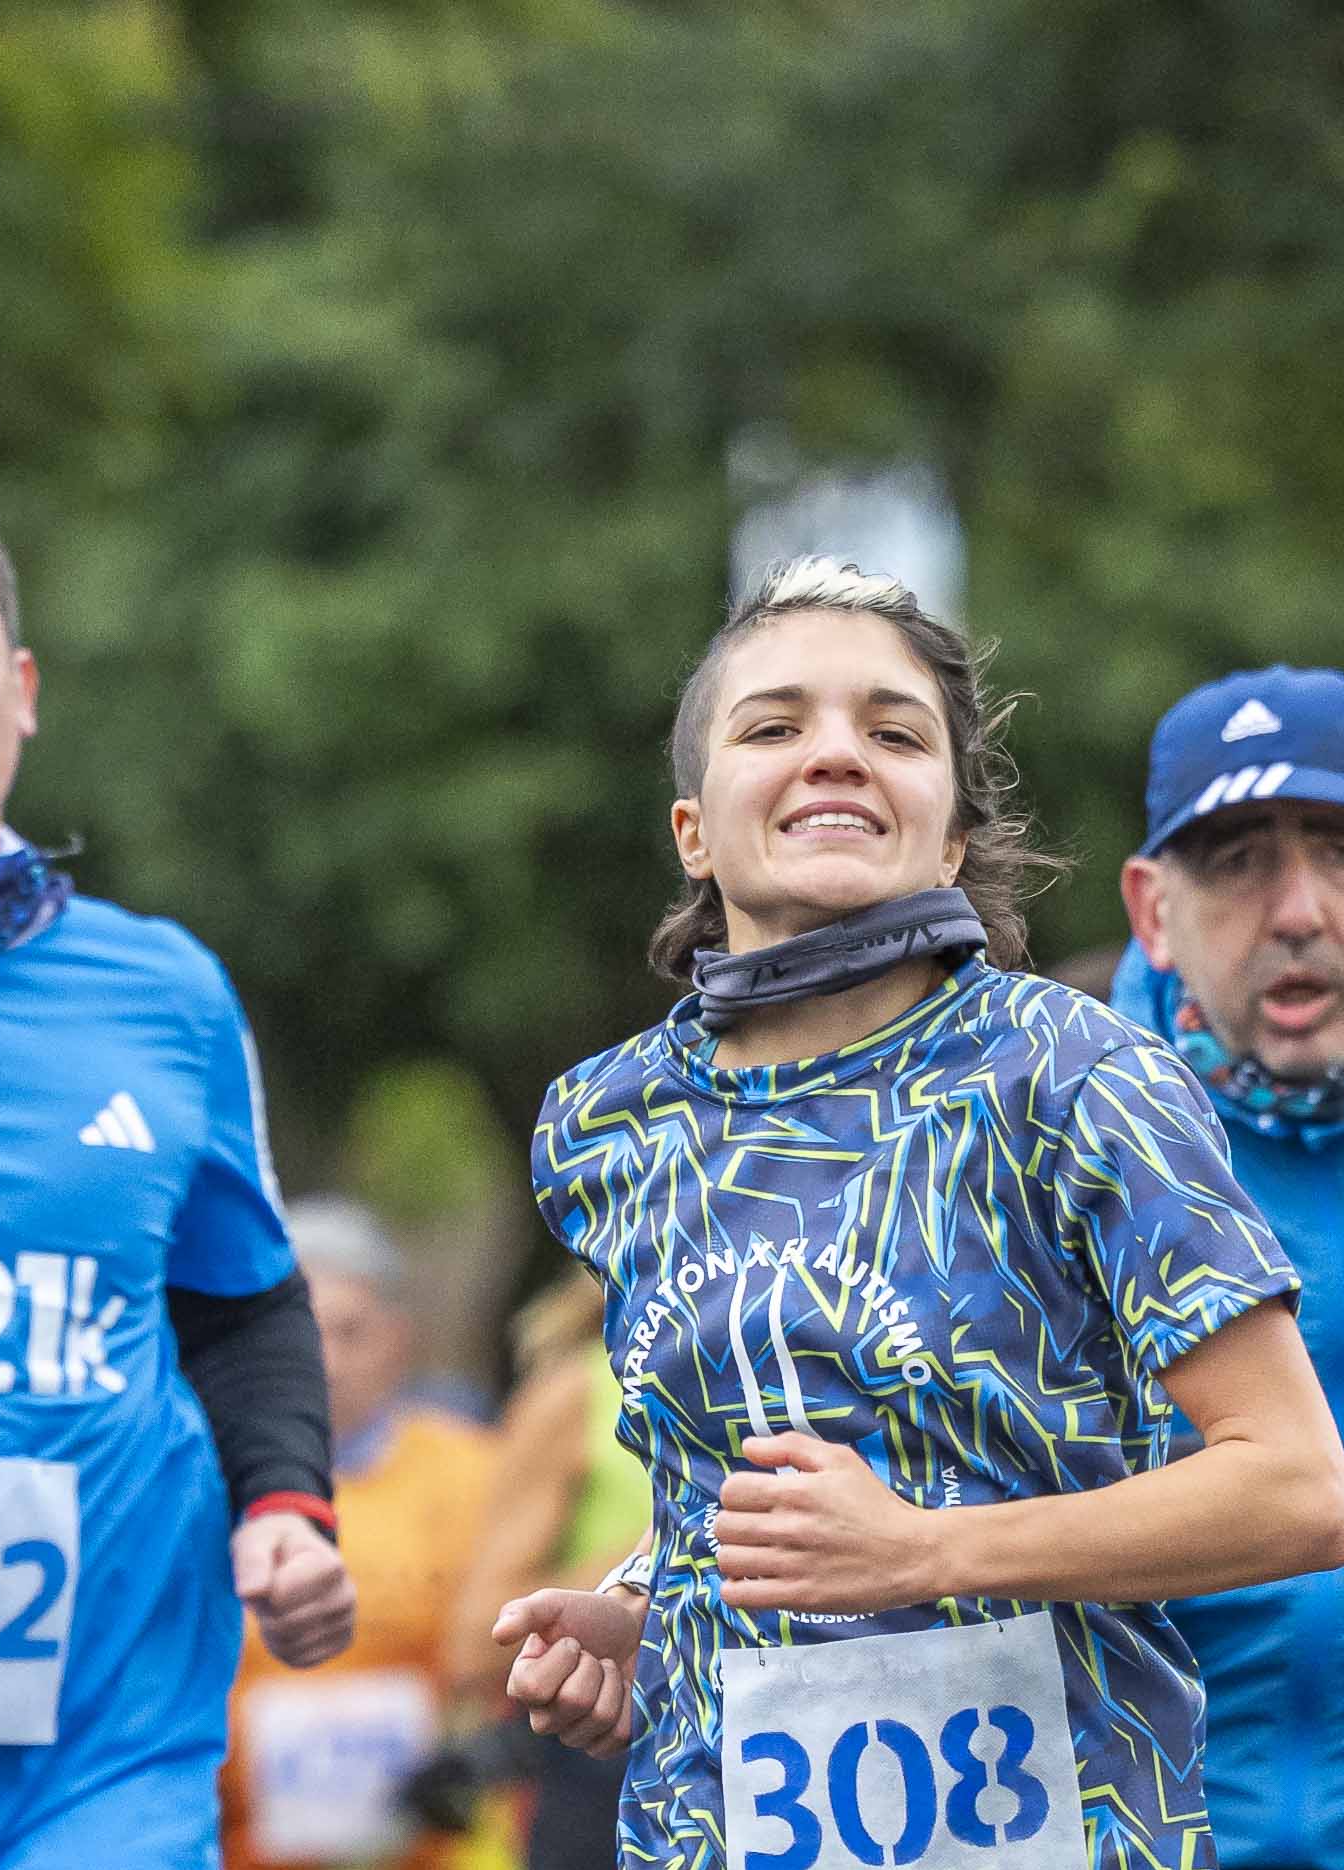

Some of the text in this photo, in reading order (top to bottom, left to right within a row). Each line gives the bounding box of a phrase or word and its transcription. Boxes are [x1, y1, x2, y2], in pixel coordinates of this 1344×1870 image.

[623, 1248, 736, 1411] MARATÓN
[744, 1241, 774, 1268] X
[813, 1243, 932, 1386] AUTISMO
